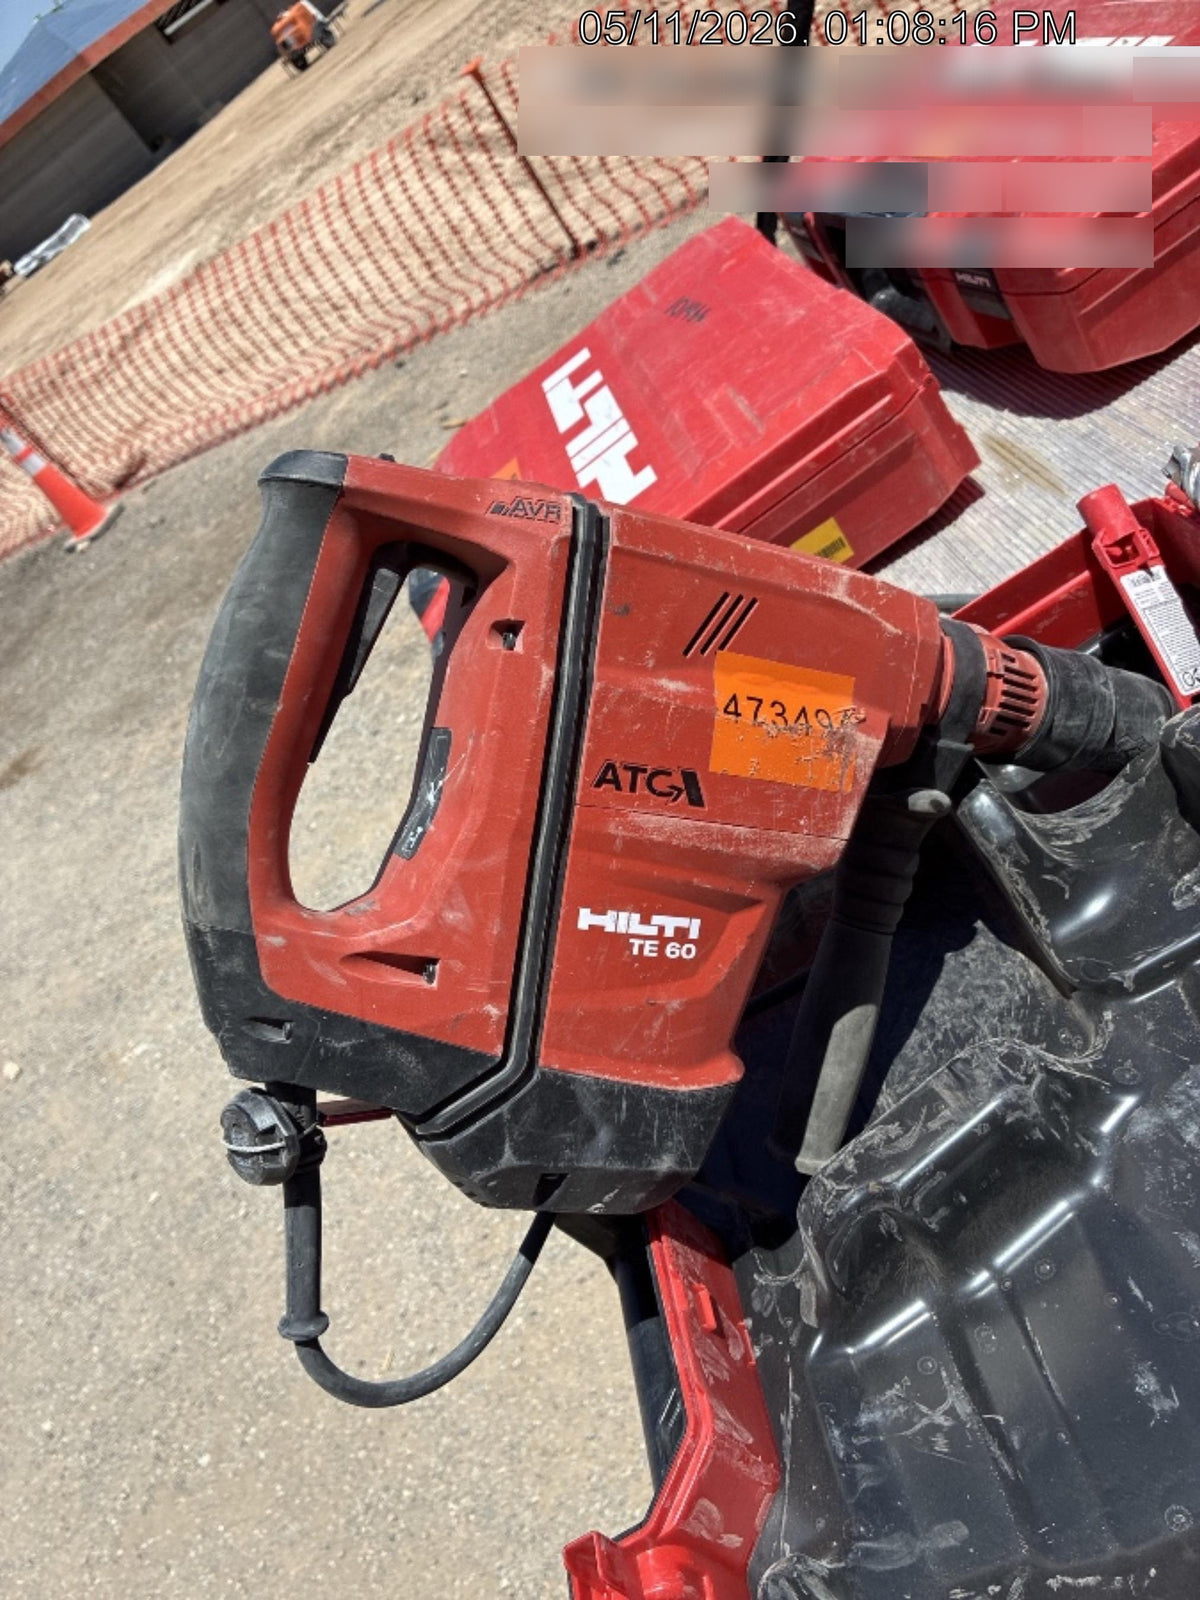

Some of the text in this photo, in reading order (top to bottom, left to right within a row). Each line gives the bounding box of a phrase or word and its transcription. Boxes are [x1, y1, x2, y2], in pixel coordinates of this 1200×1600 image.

[508, 497, 562, 521] AVR
[577, 907, 702, 939] HILTI
[628, 938, 697, 960] TE 60
